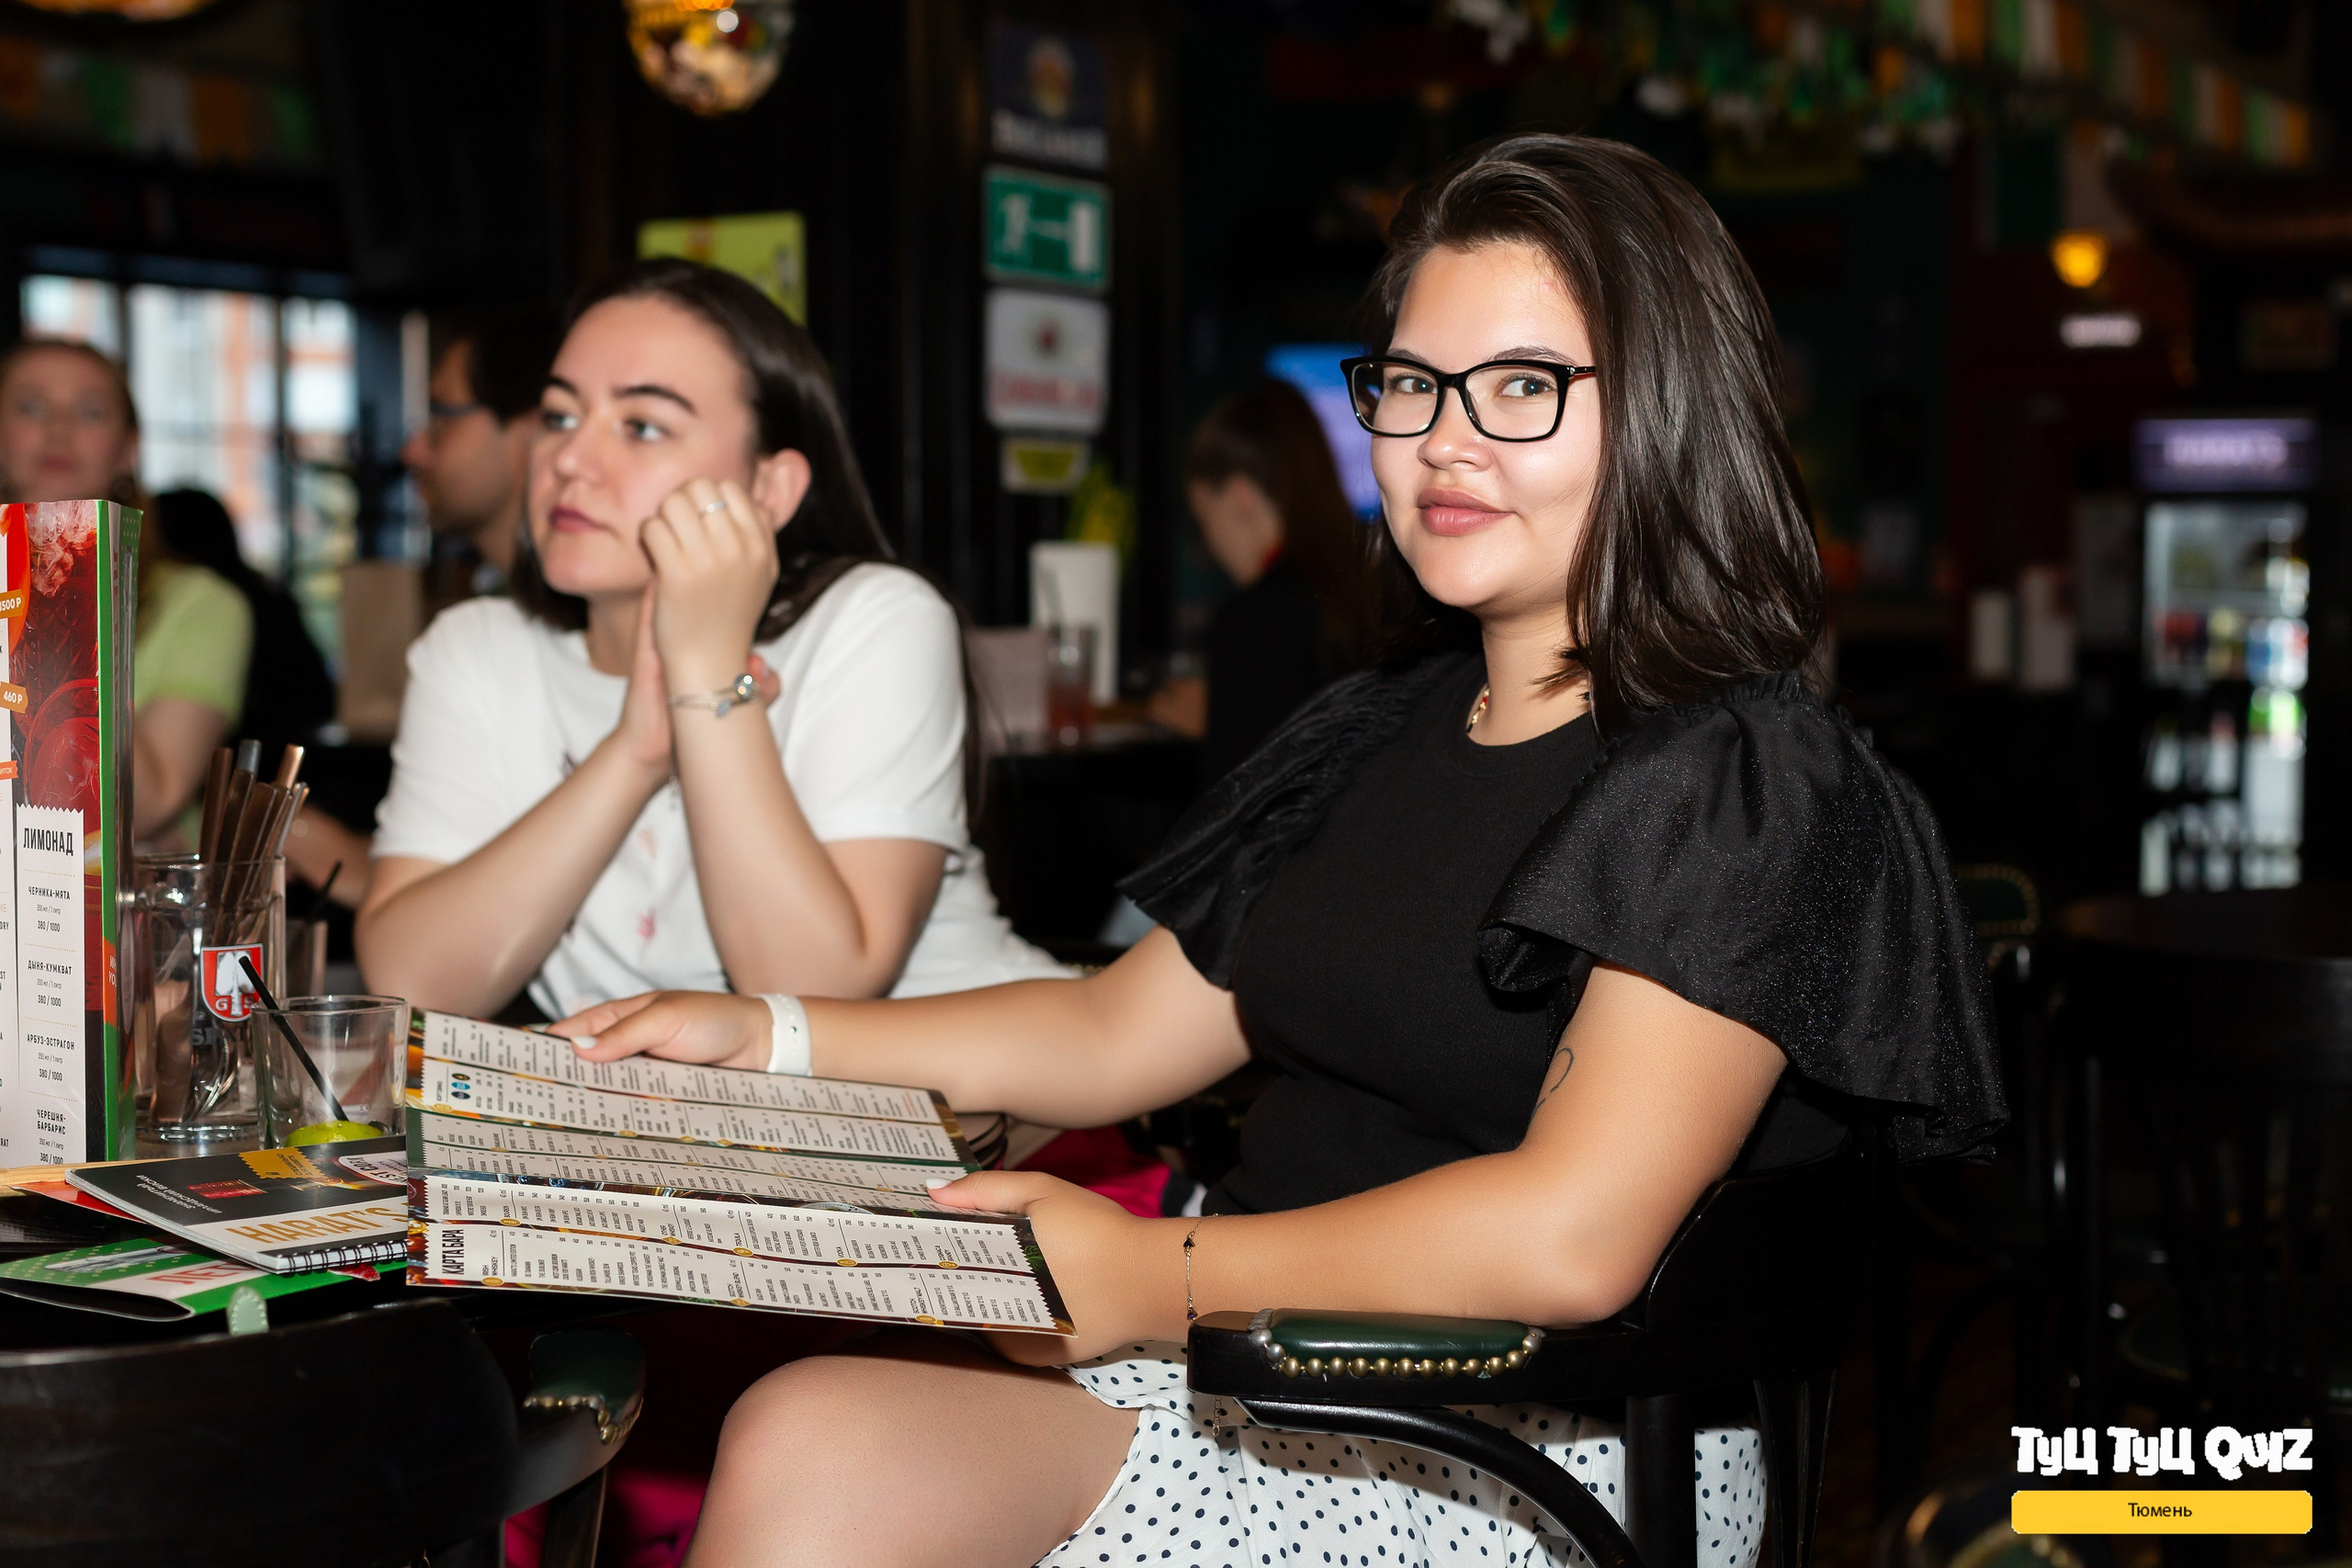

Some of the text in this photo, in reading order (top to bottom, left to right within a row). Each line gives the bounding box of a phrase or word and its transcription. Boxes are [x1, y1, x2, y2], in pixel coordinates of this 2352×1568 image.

[4, 691, 17, 704] 460
[23, 828, 74, 856] ЛИМОНАД
[28, 886, 71, 900] ЧЕРНИКА-МЯТА
[38, 920, 46, 931] 380
[50, 922, 61, 932] 1000
[28, 960, 72, 976] ДЫНЯ-КУМКВАТ
[38, 995, 46, 1005] 380
[51, 997, 62, 1008] 1000
[215, 998, 229, 1010] G
[27, 1033, 75, 1051] АРБУЗ-ЭСТРАГОН
[39, 1068, 48, 1079] 380
[51, 1071, 62, 1081] 1000
[37, 1109, 66, 1123] ЧЕРЕШНЯ-
[37, 1121, 66, 1135] БАРБАРИС
[40, 1152, 49, 1163] 380
[52, 1155, 63, 1165] 1000
[224, 1206, 394, 1244] HARAT'S
[442, 1227, 464, 1248] БАРА
[733, 1232, 742, 1247] TEQUILA
[835, 1246, 845, 1258] VODKA
[441, 1247, 464, 1275] КАРТА
[909, 1297, 920, 1314] SCOTCH
[913, 1286, 928, 1314] WHISKEY MALT
